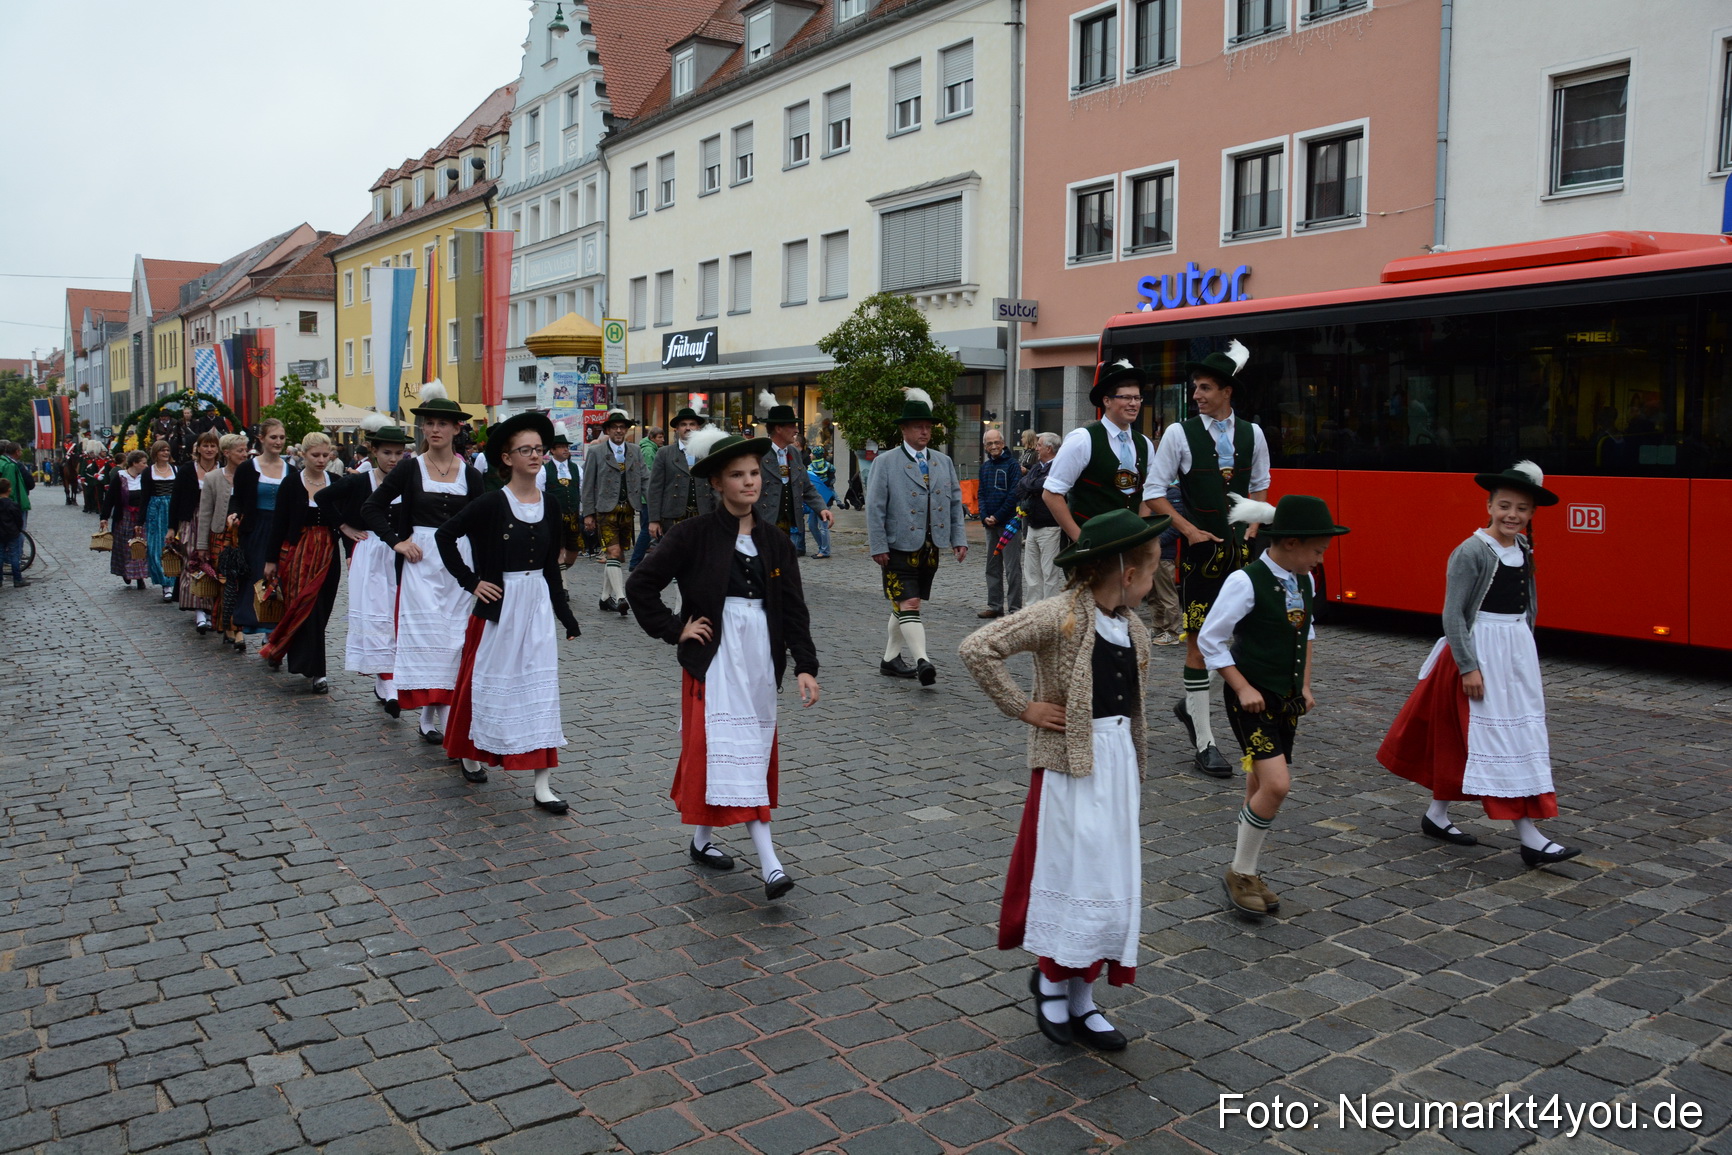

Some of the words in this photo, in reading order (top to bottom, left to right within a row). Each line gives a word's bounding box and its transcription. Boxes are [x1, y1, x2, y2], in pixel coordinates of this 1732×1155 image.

[1000, 303, 1037, 318] sutor.
[610, 327, 619, 339] H
[662, 331, 713, 365] frühauf
[1573, 508, 1600, 528] DB
